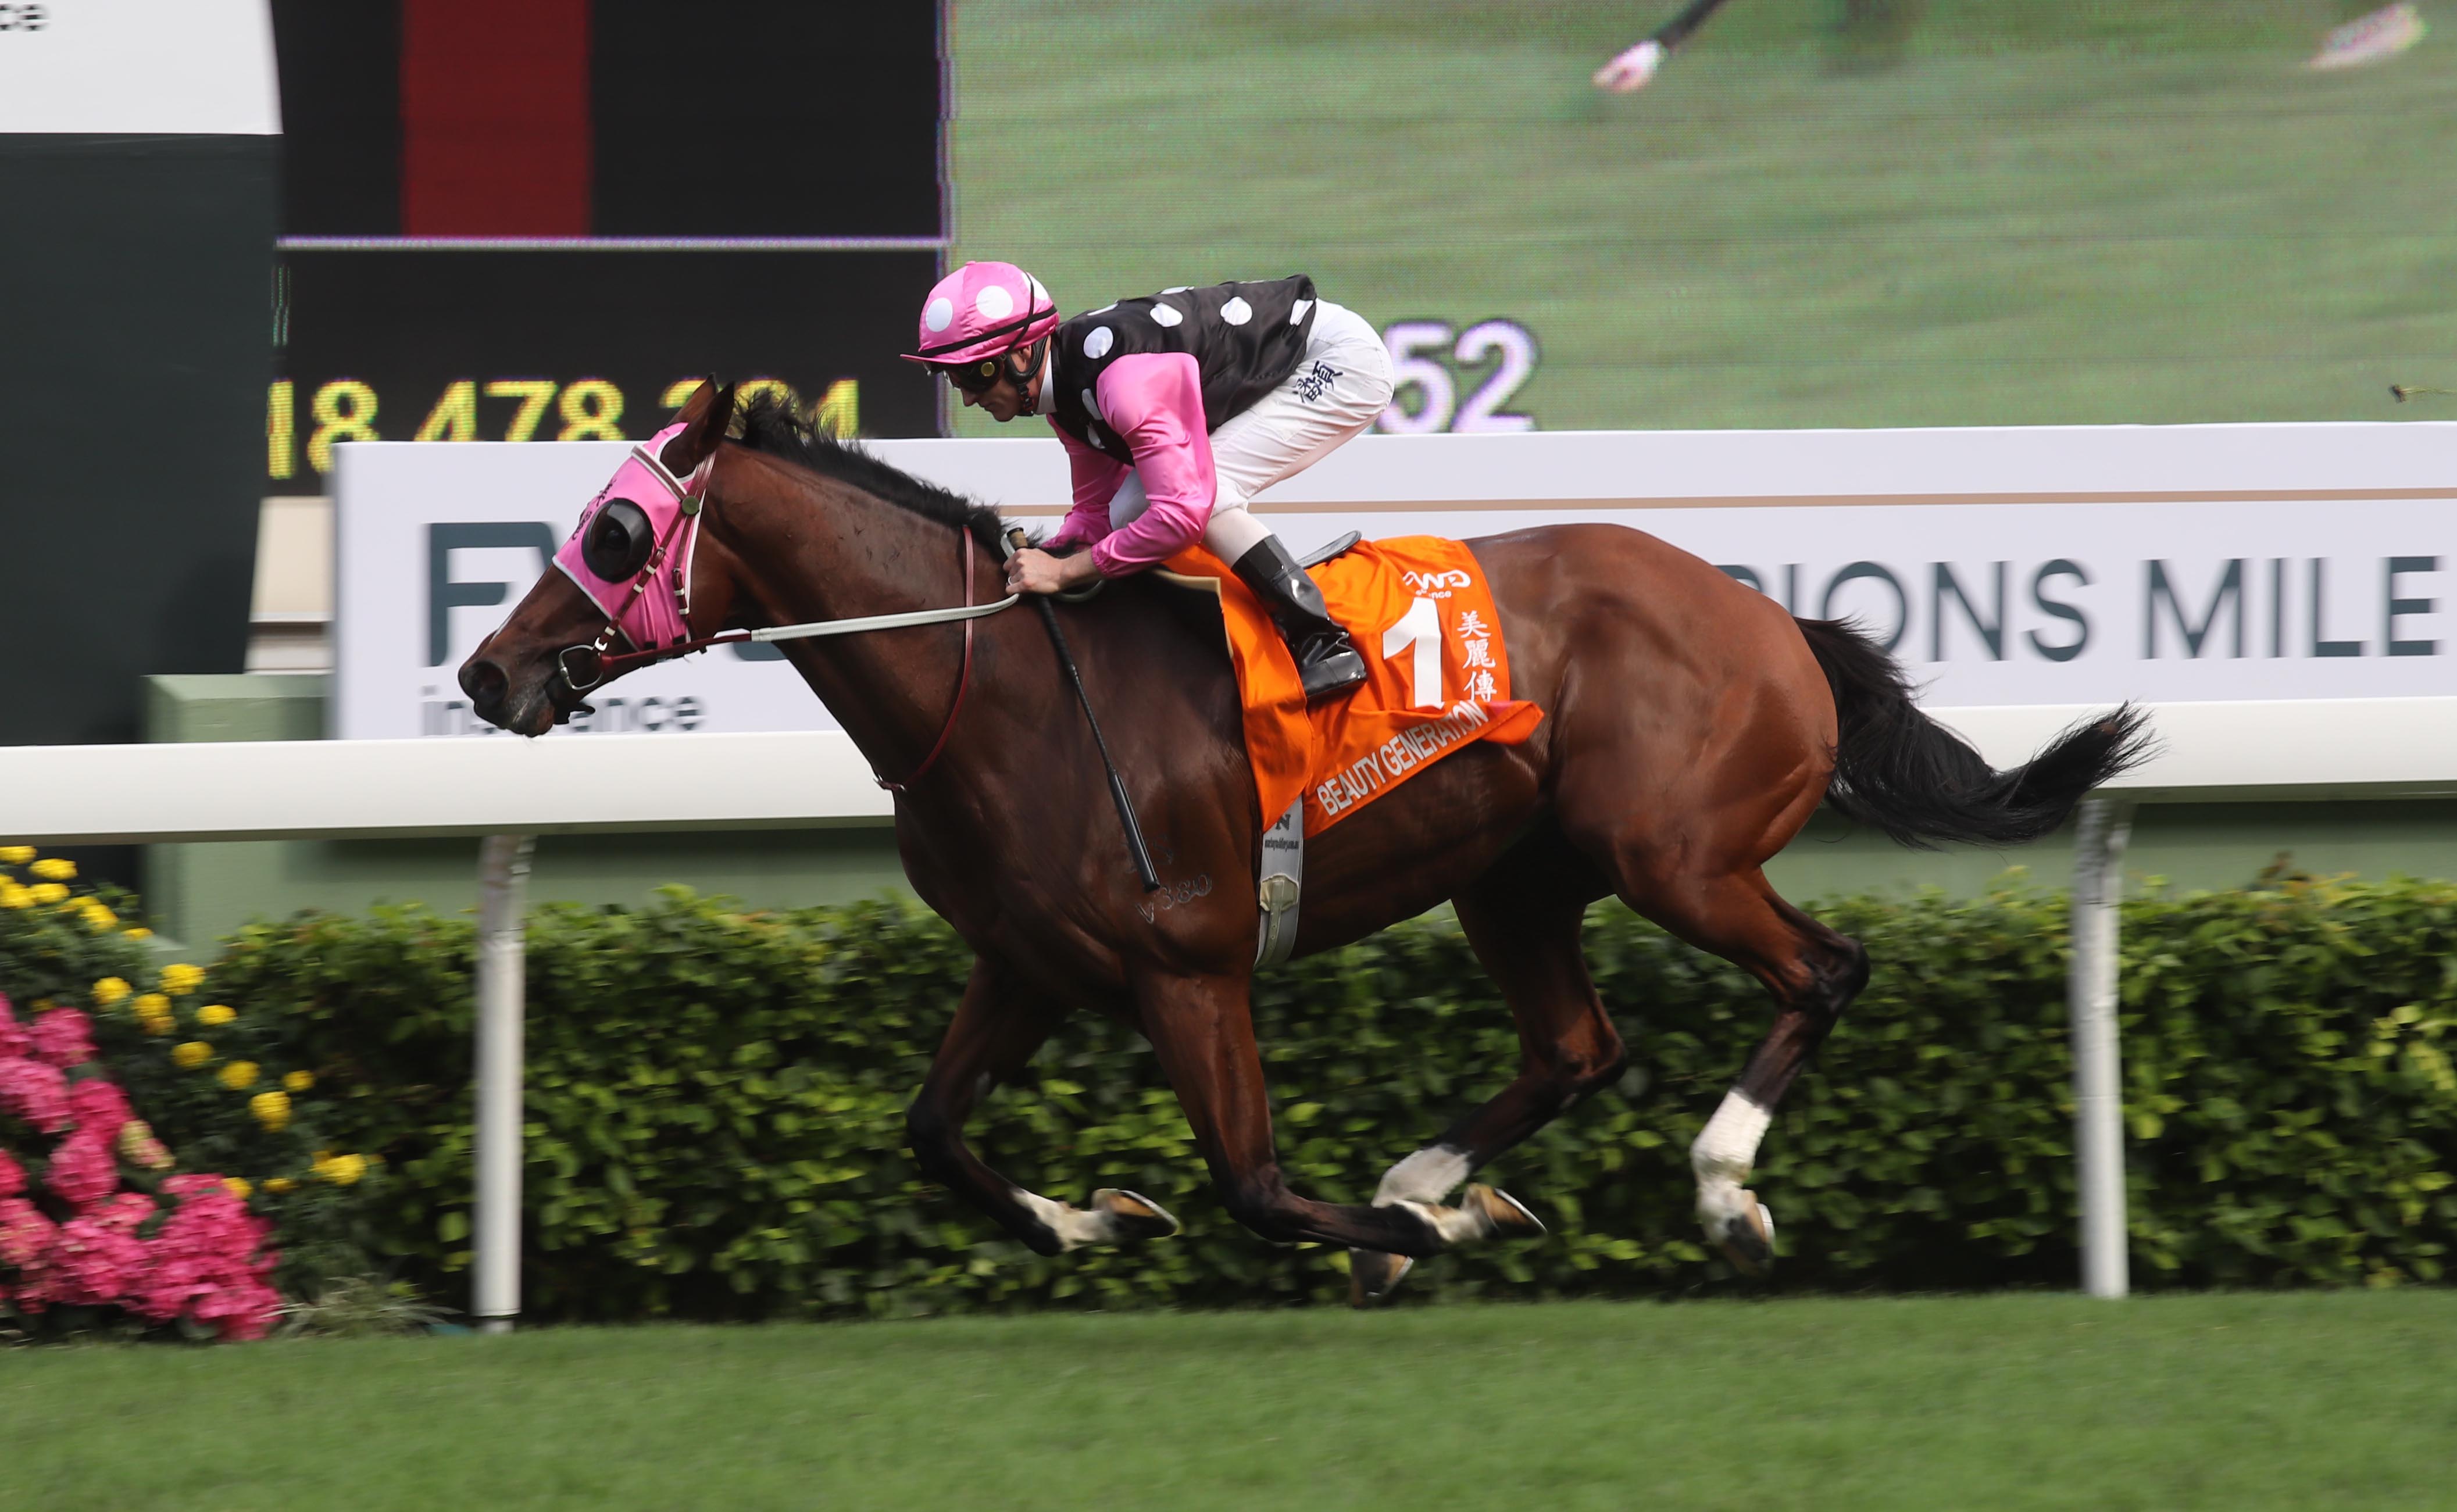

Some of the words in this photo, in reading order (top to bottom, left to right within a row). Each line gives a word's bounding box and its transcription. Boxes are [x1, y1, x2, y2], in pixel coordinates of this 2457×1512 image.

[1383, 596, 1445, 710] 1
[1456, 610, 1498, 702] 美麗傳
[2138, 555, 2447, 659] MILE
[1316, 752, 1386, 816] BEAUTY
[1380, 700, 1488, 777] GENERATION
